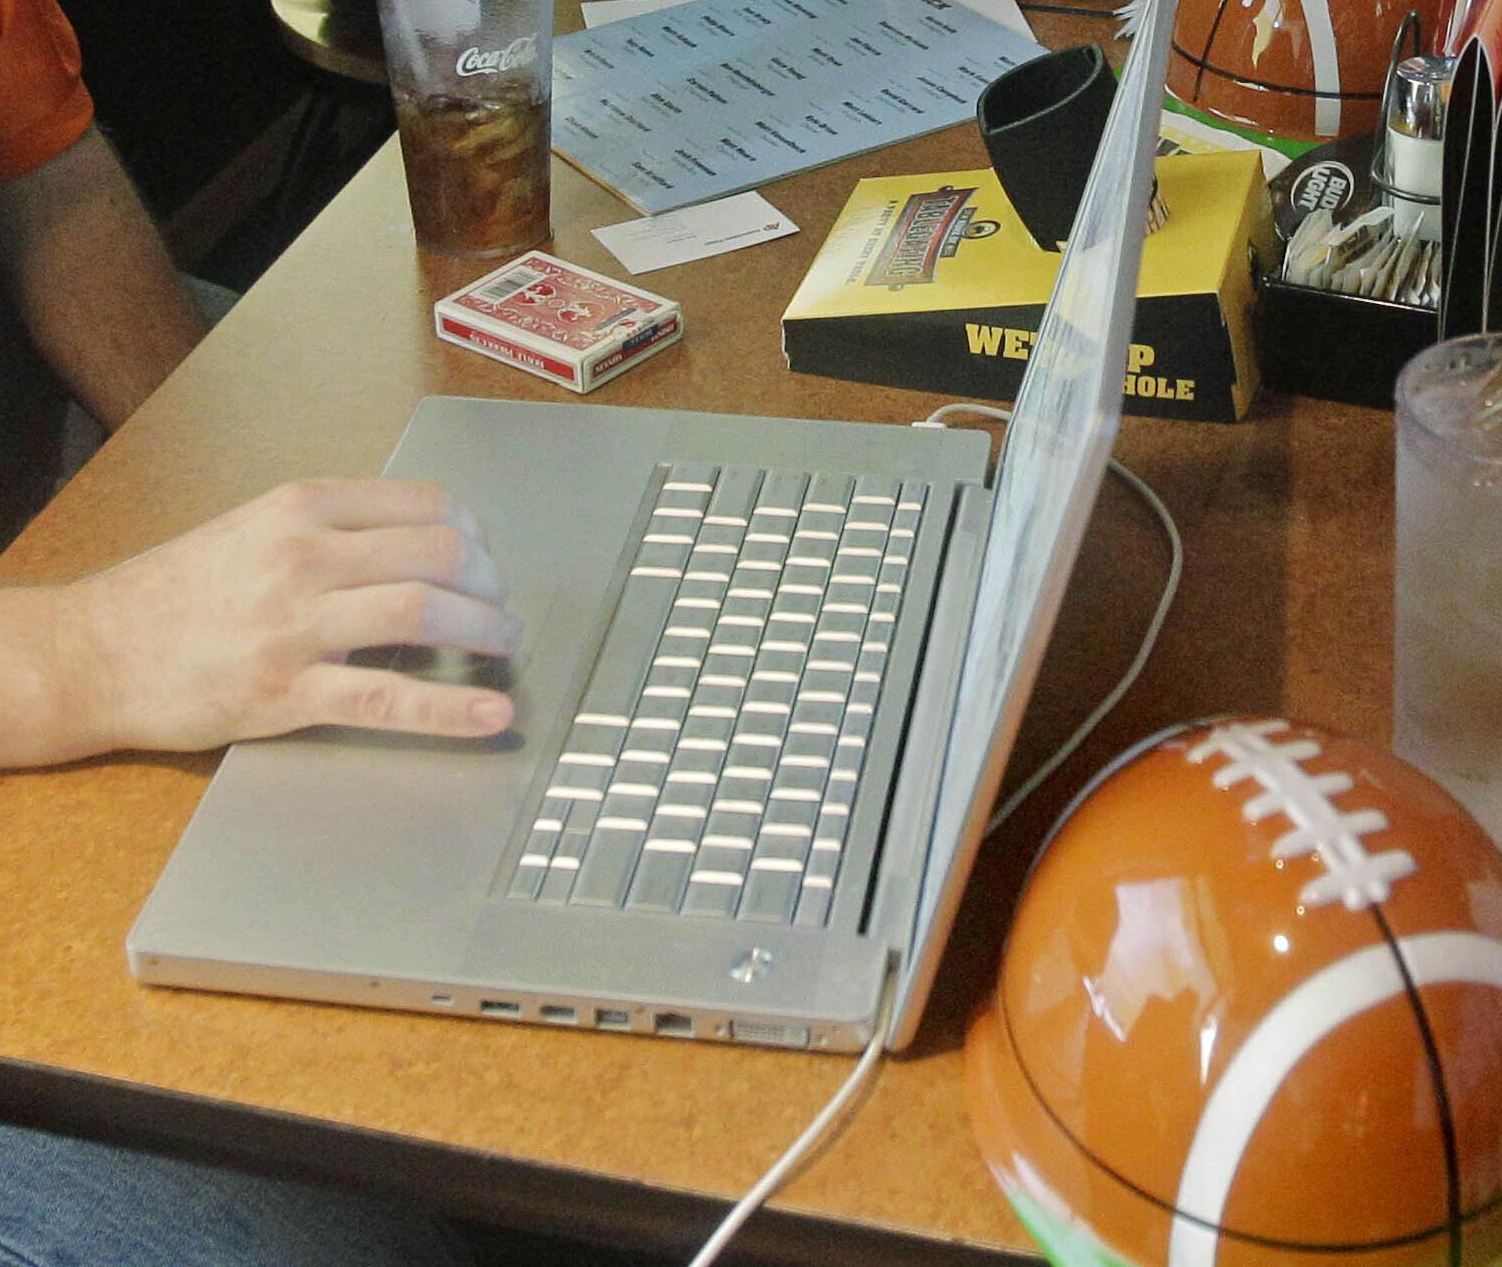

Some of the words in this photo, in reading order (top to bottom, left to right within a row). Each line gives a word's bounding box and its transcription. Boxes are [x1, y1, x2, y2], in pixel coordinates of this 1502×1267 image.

[1298, 167, 1330, 211] LIGHT
[1319, 175, 1348, 210] BUD
[965, 323, 1038, 361] WE
[1124, 375, 1195, 401] HOLE
